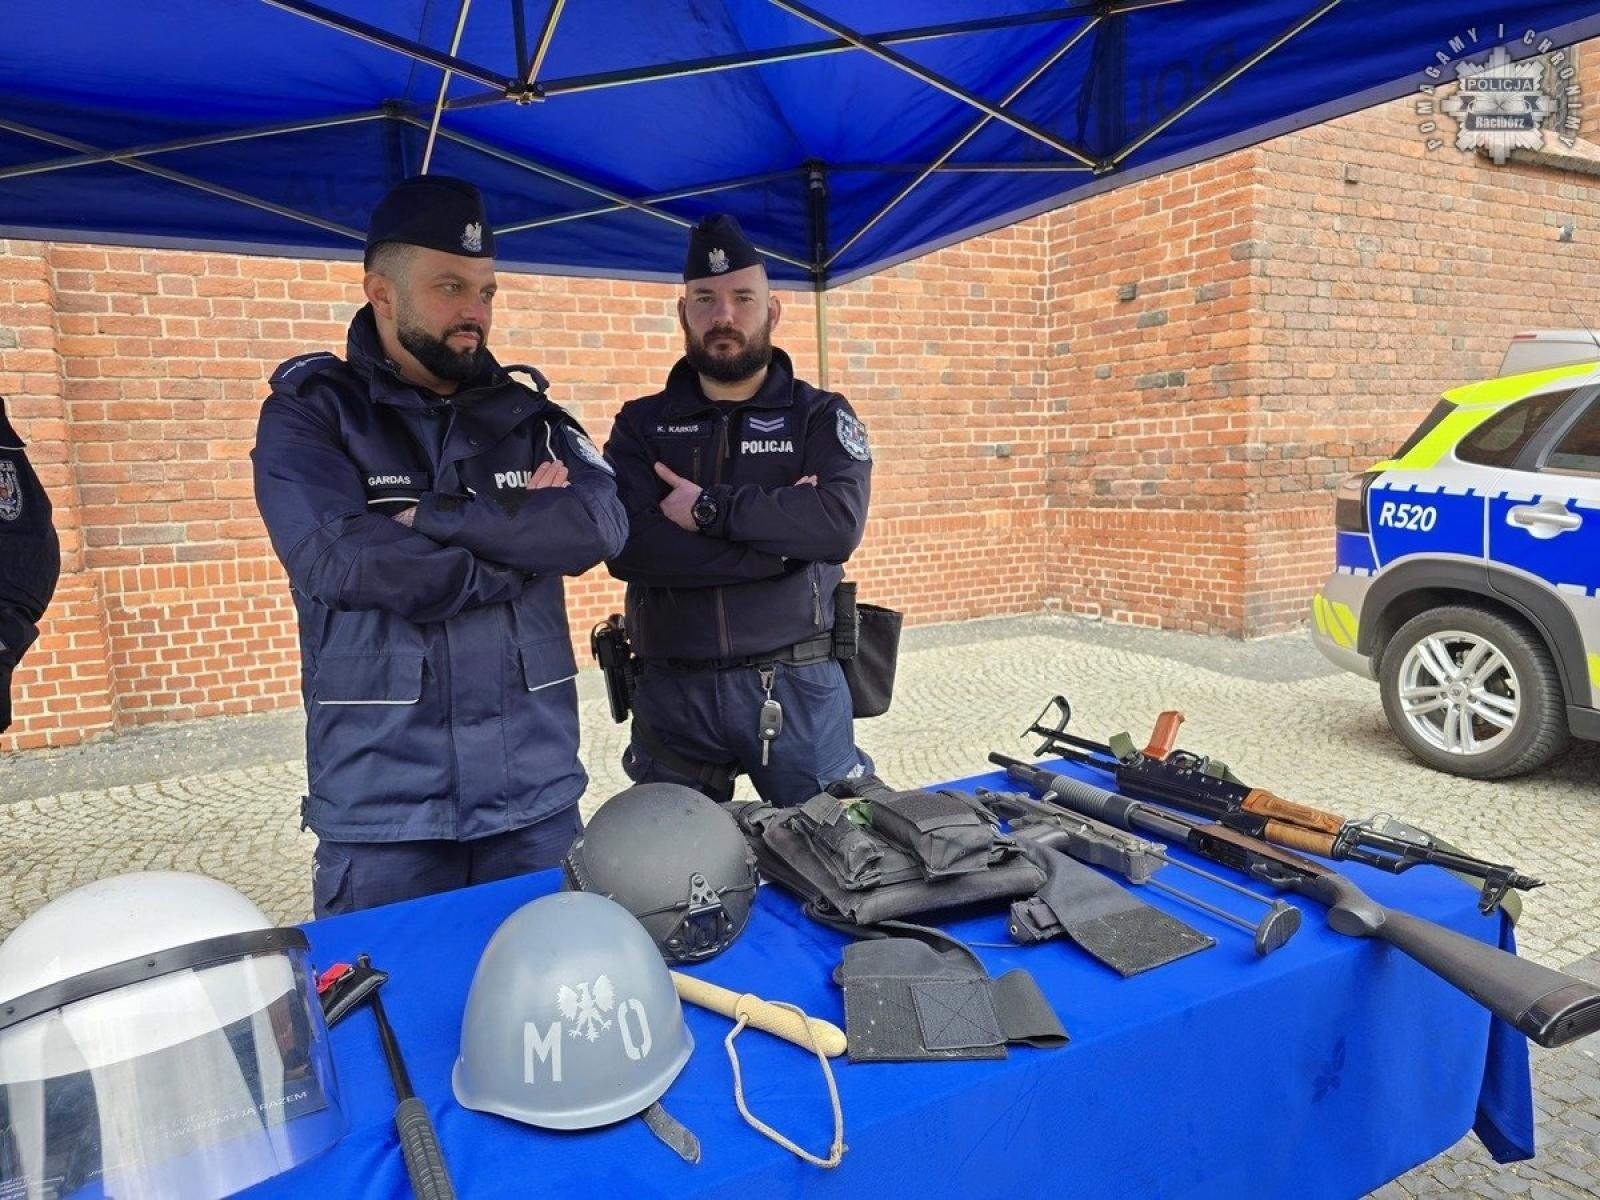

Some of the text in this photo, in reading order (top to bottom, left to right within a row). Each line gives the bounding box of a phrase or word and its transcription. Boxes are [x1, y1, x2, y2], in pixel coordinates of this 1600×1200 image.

[740, 440, 794, 454] POLICJA
[367, 475, 411, 486] GARDAS
[1379, 501, 1437, 532] R520
[523, 998, 652, 1085] M O
[259, 1091, 309, 1112] RAZEM
